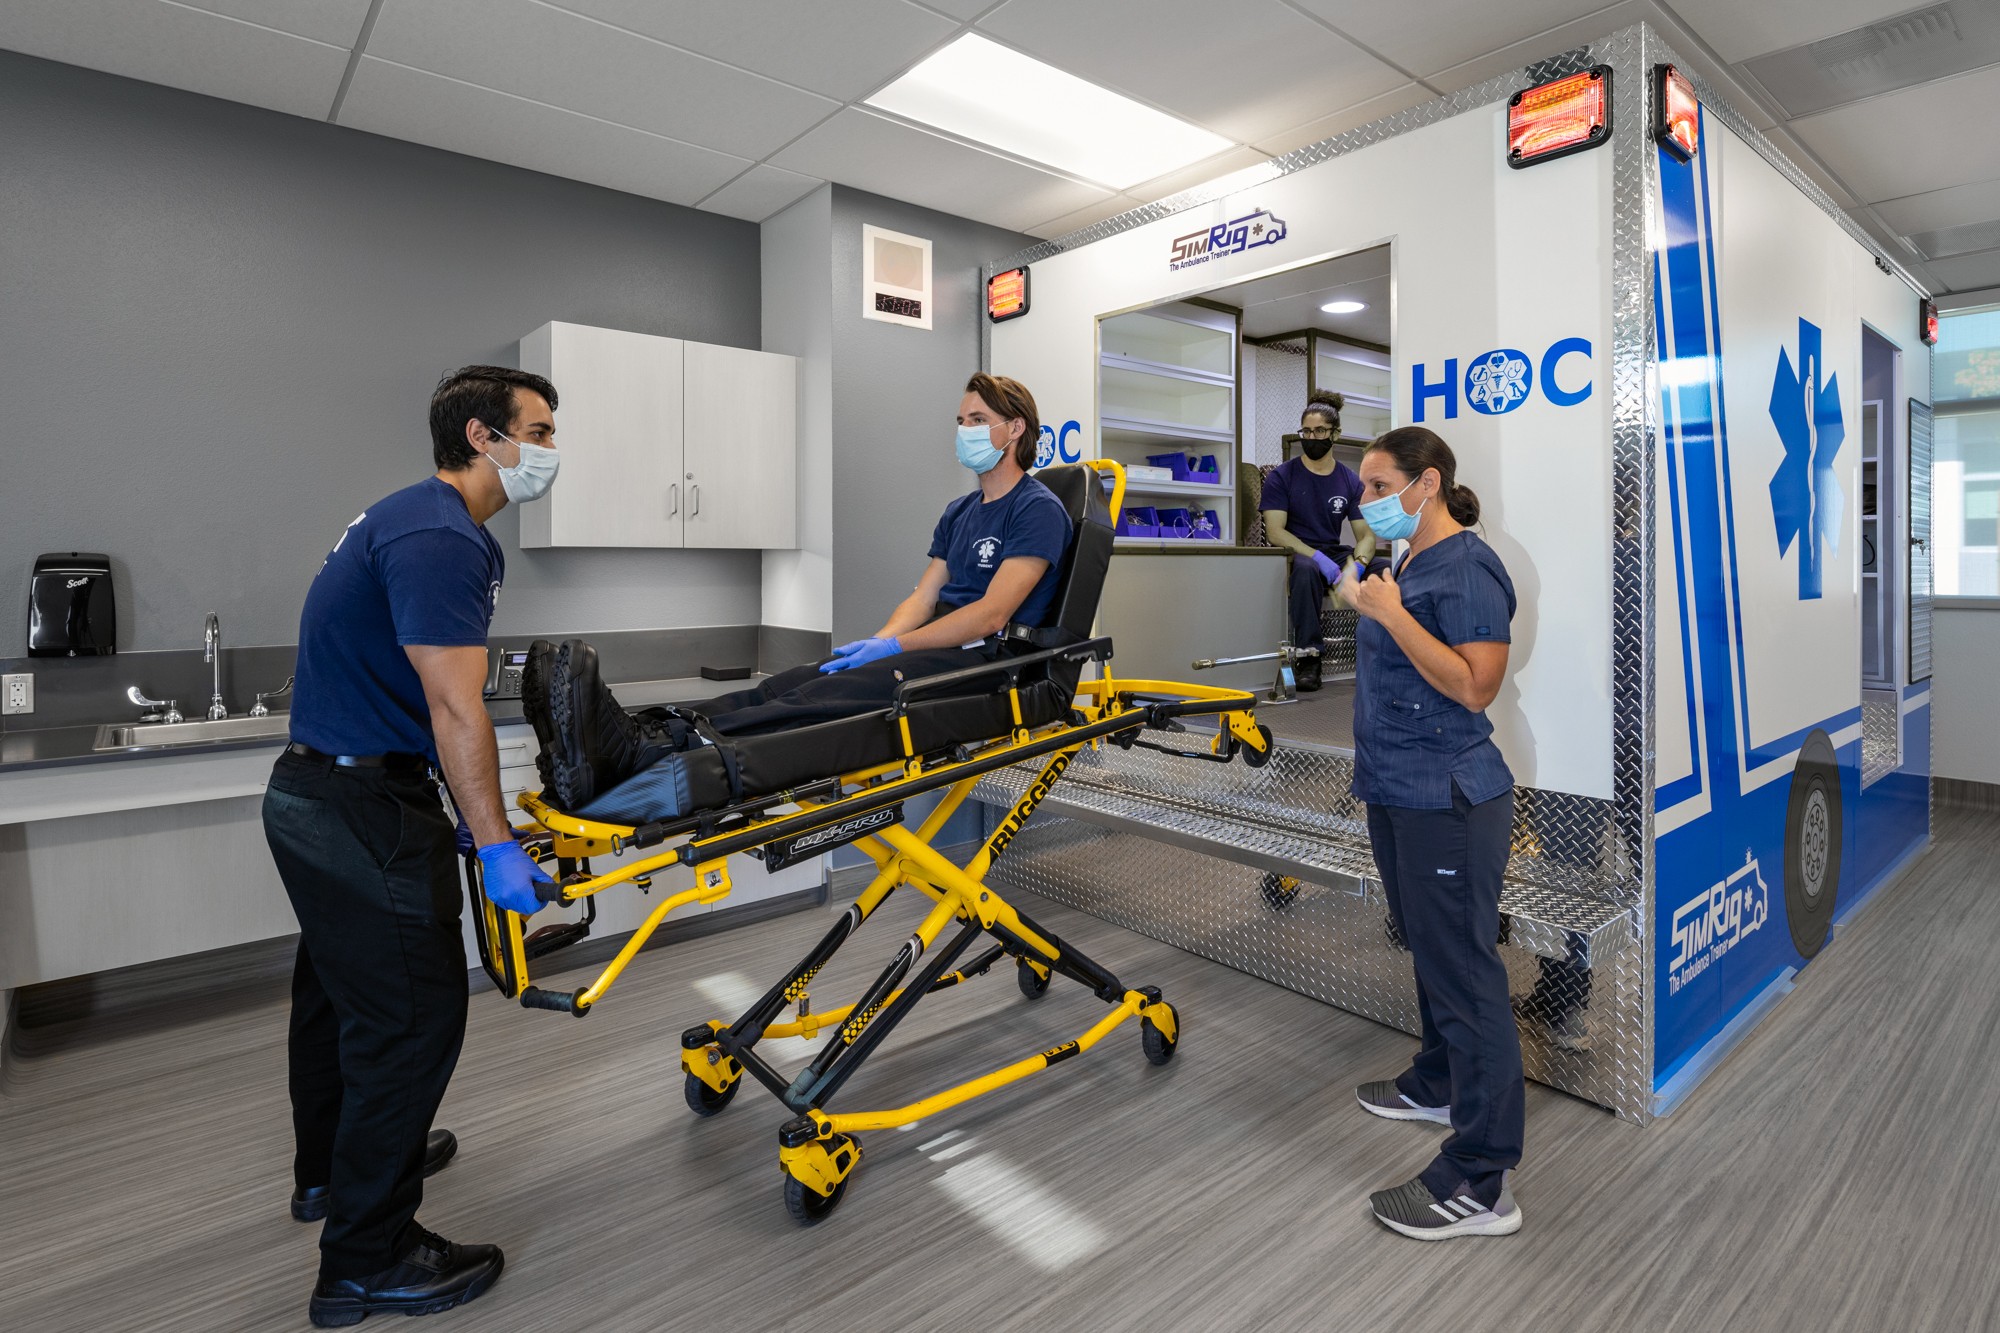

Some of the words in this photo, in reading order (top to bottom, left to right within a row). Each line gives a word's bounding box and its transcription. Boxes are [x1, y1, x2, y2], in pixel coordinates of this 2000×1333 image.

[1169, 263, 1179, 272] The
[1180, 255, 1210, 269] Ambulance
[1211, 249, 1231, 260] Trainer
[1413, 337, 1592, 423] HOC
[1032, 420, 1081, 469] OC
[66, 576, 89, 589] Scott
[794, 808, 893, 849] MX-PRO
[989, 756, 1069, 856] RUGGED
[1669, 973, 1680, 997] The
[1681, 952, 1710, 988] Ambulance
[1710, 938, 1729, 964] Trainer
